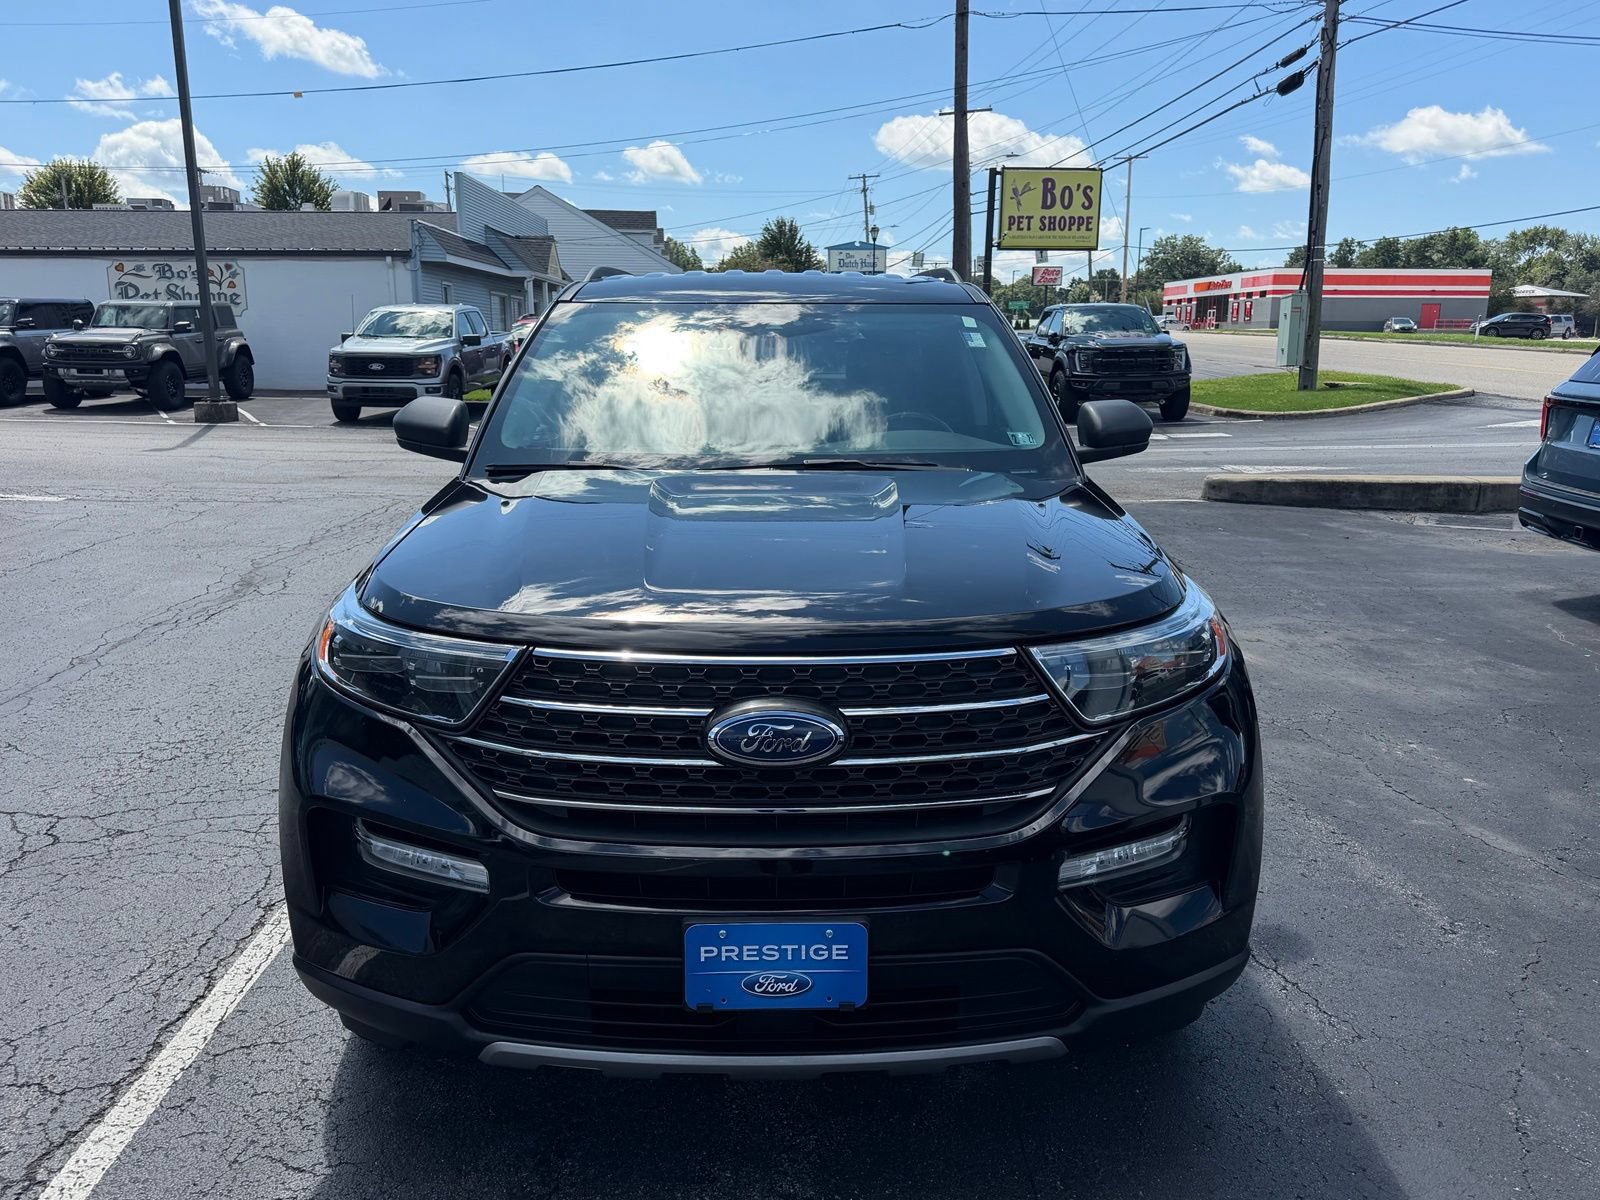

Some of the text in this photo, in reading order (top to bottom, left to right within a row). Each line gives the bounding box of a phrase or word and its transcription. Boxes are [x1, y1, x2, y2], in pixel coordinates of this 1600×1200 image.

[1007, 215, 1094, 232] PET SHOPPE
[1036, 275, 1058, 284] Zone
[1041, 268, 1061, 276] Auto
[740, 723, 813, 753] Ford
[700, 944, 849, 962] PRESTIGE
[754, 974, 798, 993] Ford
